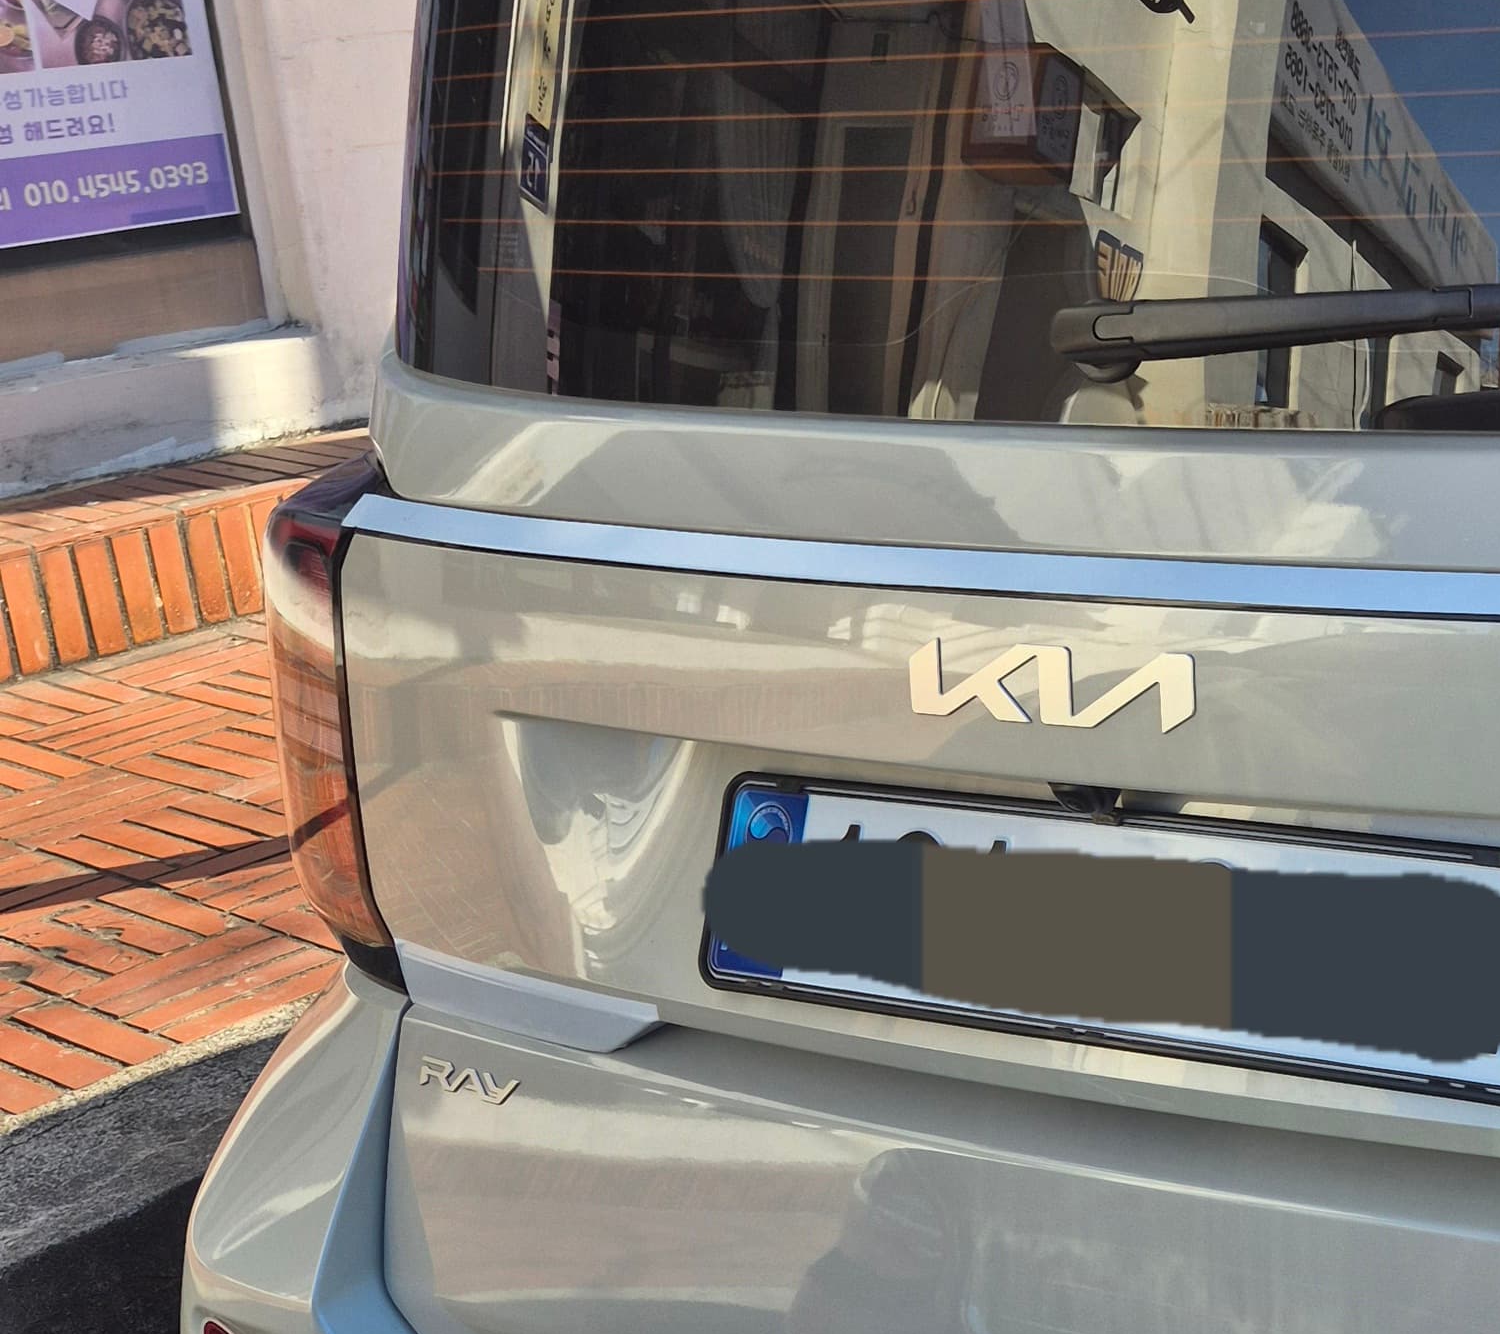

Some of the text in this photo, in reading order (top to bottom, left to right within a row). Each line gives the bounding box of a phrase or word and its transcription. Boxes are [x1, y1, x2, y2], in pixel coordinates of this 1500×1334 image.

[0, 79, 128, 111] 성가능합니다
[23, 113, 115, 142] 해드려요!
[23, 162, 209, 207] 010.4545.0393
[908, 636, 1197, 734] KIA
[418, 1054, 521, 1105] RAY
